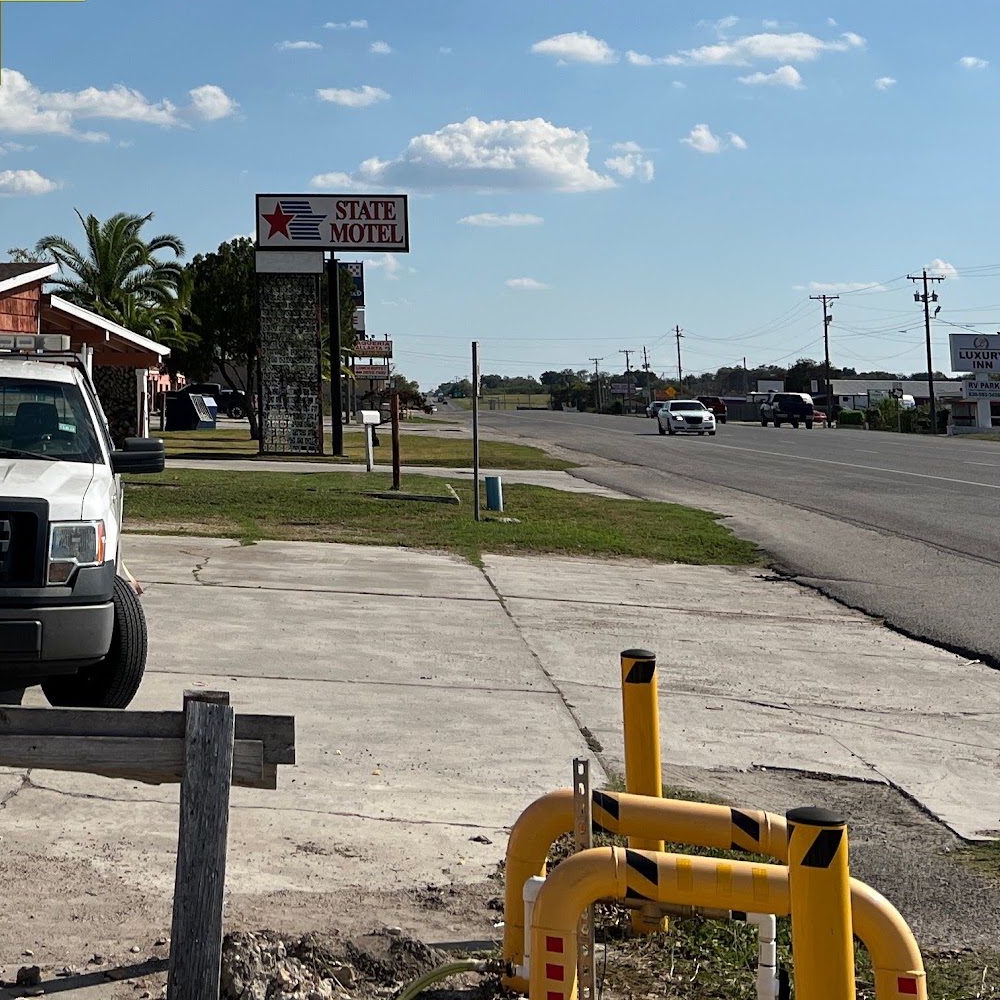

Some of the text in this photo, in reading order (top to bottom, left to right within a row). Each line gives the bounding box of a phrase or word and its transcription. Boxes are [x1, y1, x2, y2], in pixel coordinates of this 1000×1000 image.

[335, 200, 396, 221] STATE
[329, 223, 404, 244] MOTEL
[973, 361, 993, 369] INN
